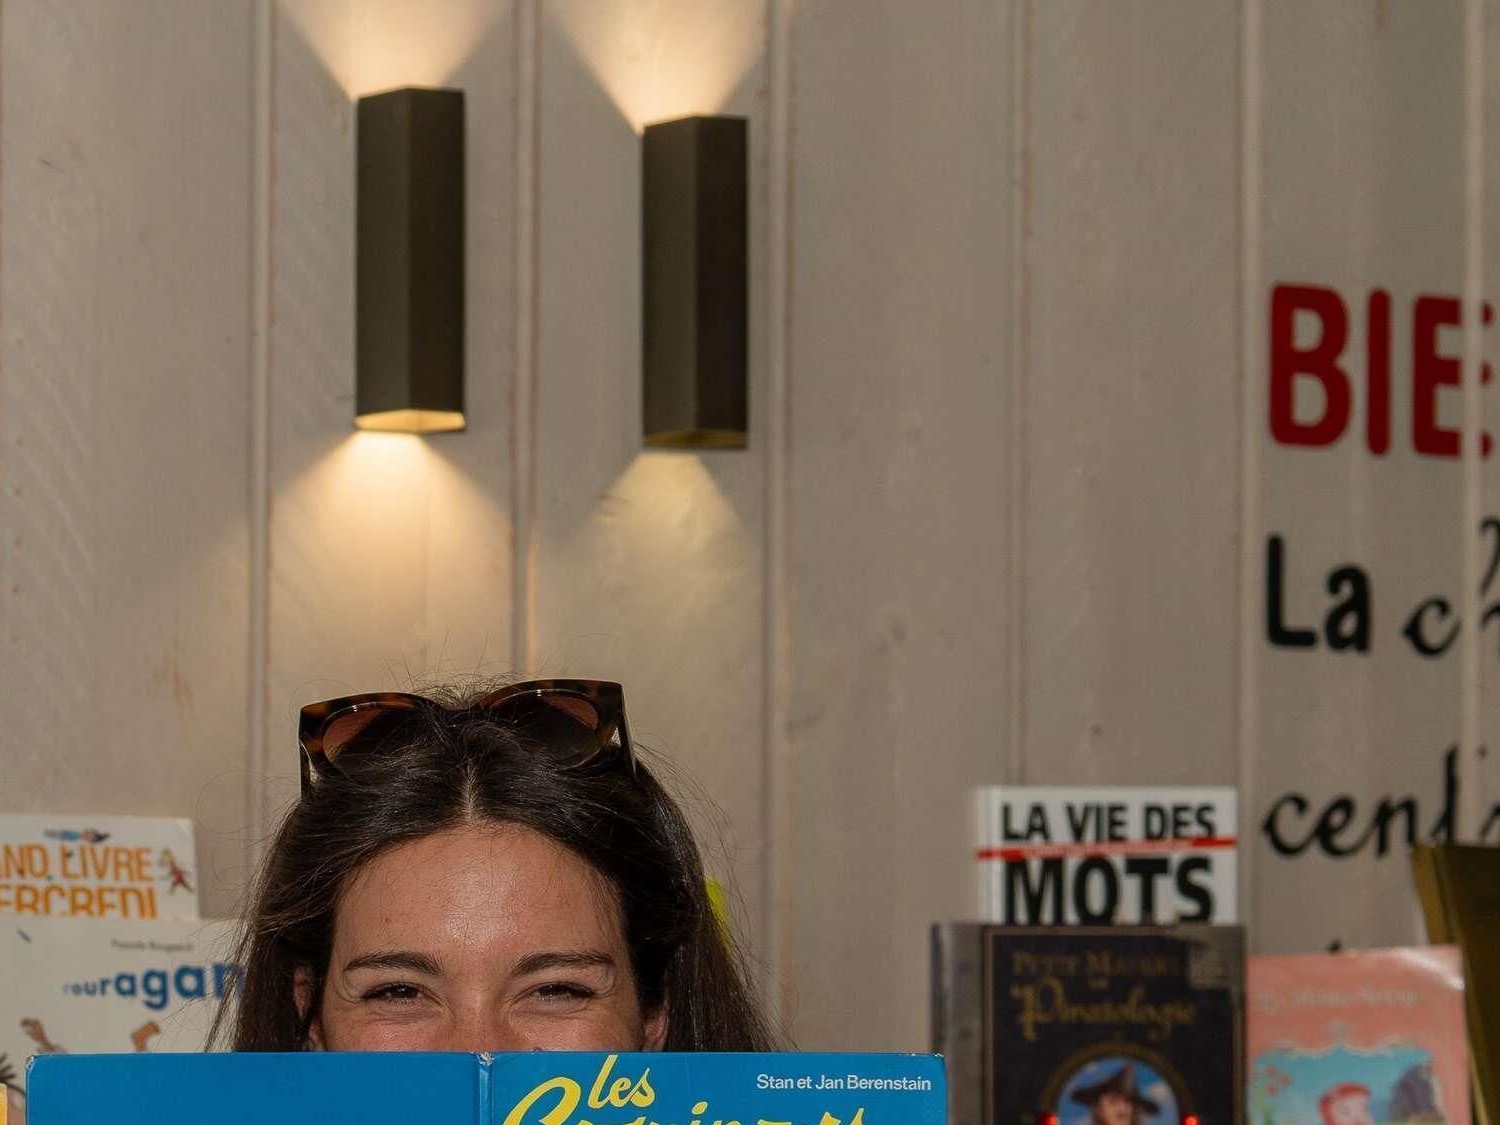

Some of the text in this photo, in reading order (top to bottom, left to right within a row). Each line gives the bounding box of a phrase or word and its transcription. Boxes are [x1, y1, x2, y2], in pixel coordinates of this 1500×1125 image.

[1266, 534, 1372, 653] La
[1002, 803, 1216, 841] LA VIE DES
[60, 844, 155, 882] LIVRE
[1003, 854, 1215, 925] MOTS
[588, 1054, 656, 1109] les
[757, 1074, 932, 1091] Stan et Jan Berenstain
